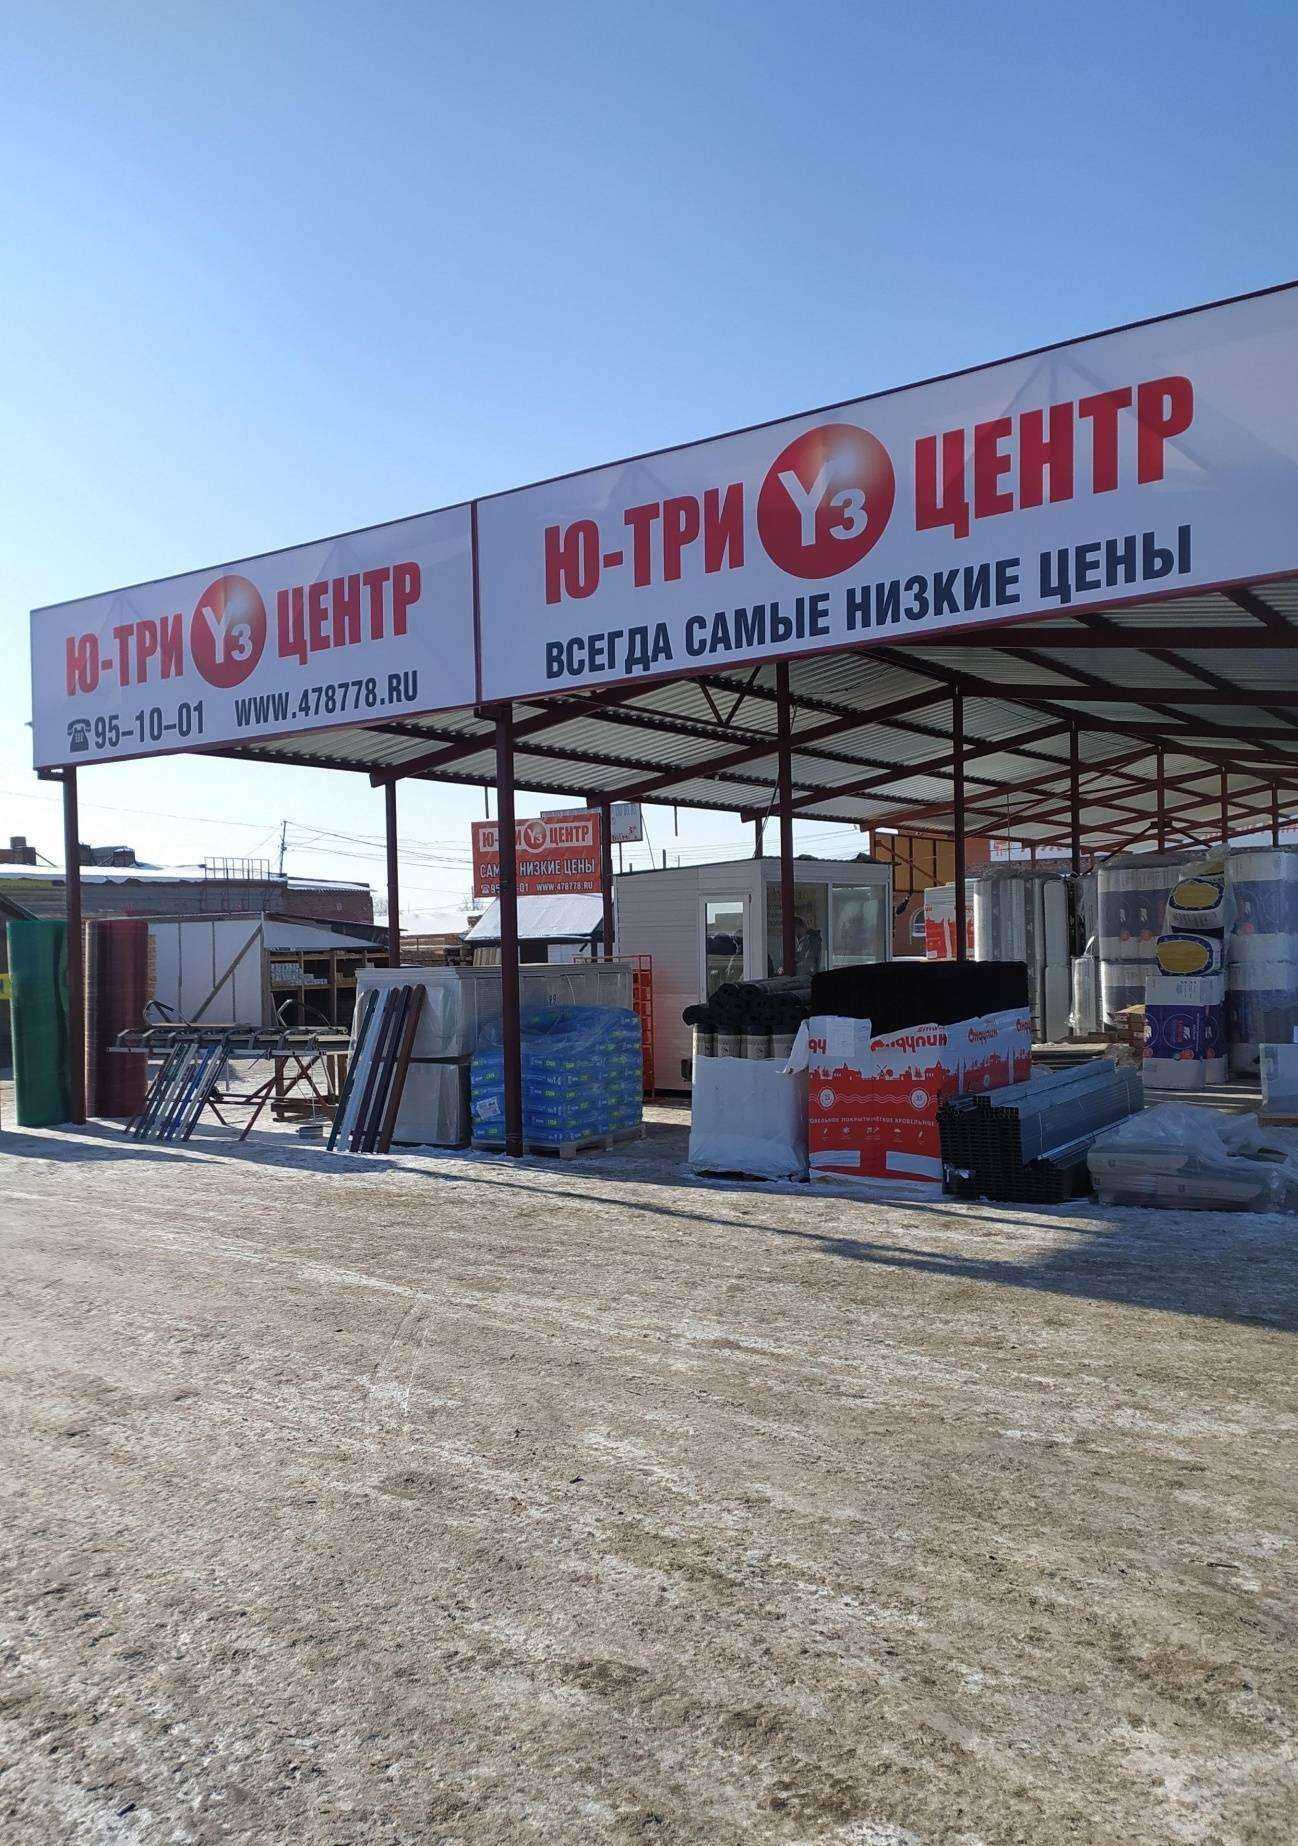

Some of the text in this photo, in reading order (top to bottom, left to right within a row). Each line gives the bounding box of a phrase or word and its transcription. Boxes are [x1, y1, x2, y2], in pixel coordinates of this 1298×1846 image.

[545, 482, 744, 604] Ю-ТРИ
[915, 375, 1194, 539] ЦЕНТР
[66, 613, 183, 696] Ю-ТРИ
[277, 561, 421, 666] ЦЕНТР
[546, 524, 1192, 679] ВСЕГДА САМЫЕ НИЗКИЕ ЦЕНЫ
[95, 670, 418, 750] 95-10-01 WWW.478778.RU
[520, 860, 560, 876] НИЗКИЕ
[564, 859, 595, 877] ЦЕНЫ
[550, 824, 590, 846] ЦЕНТР
